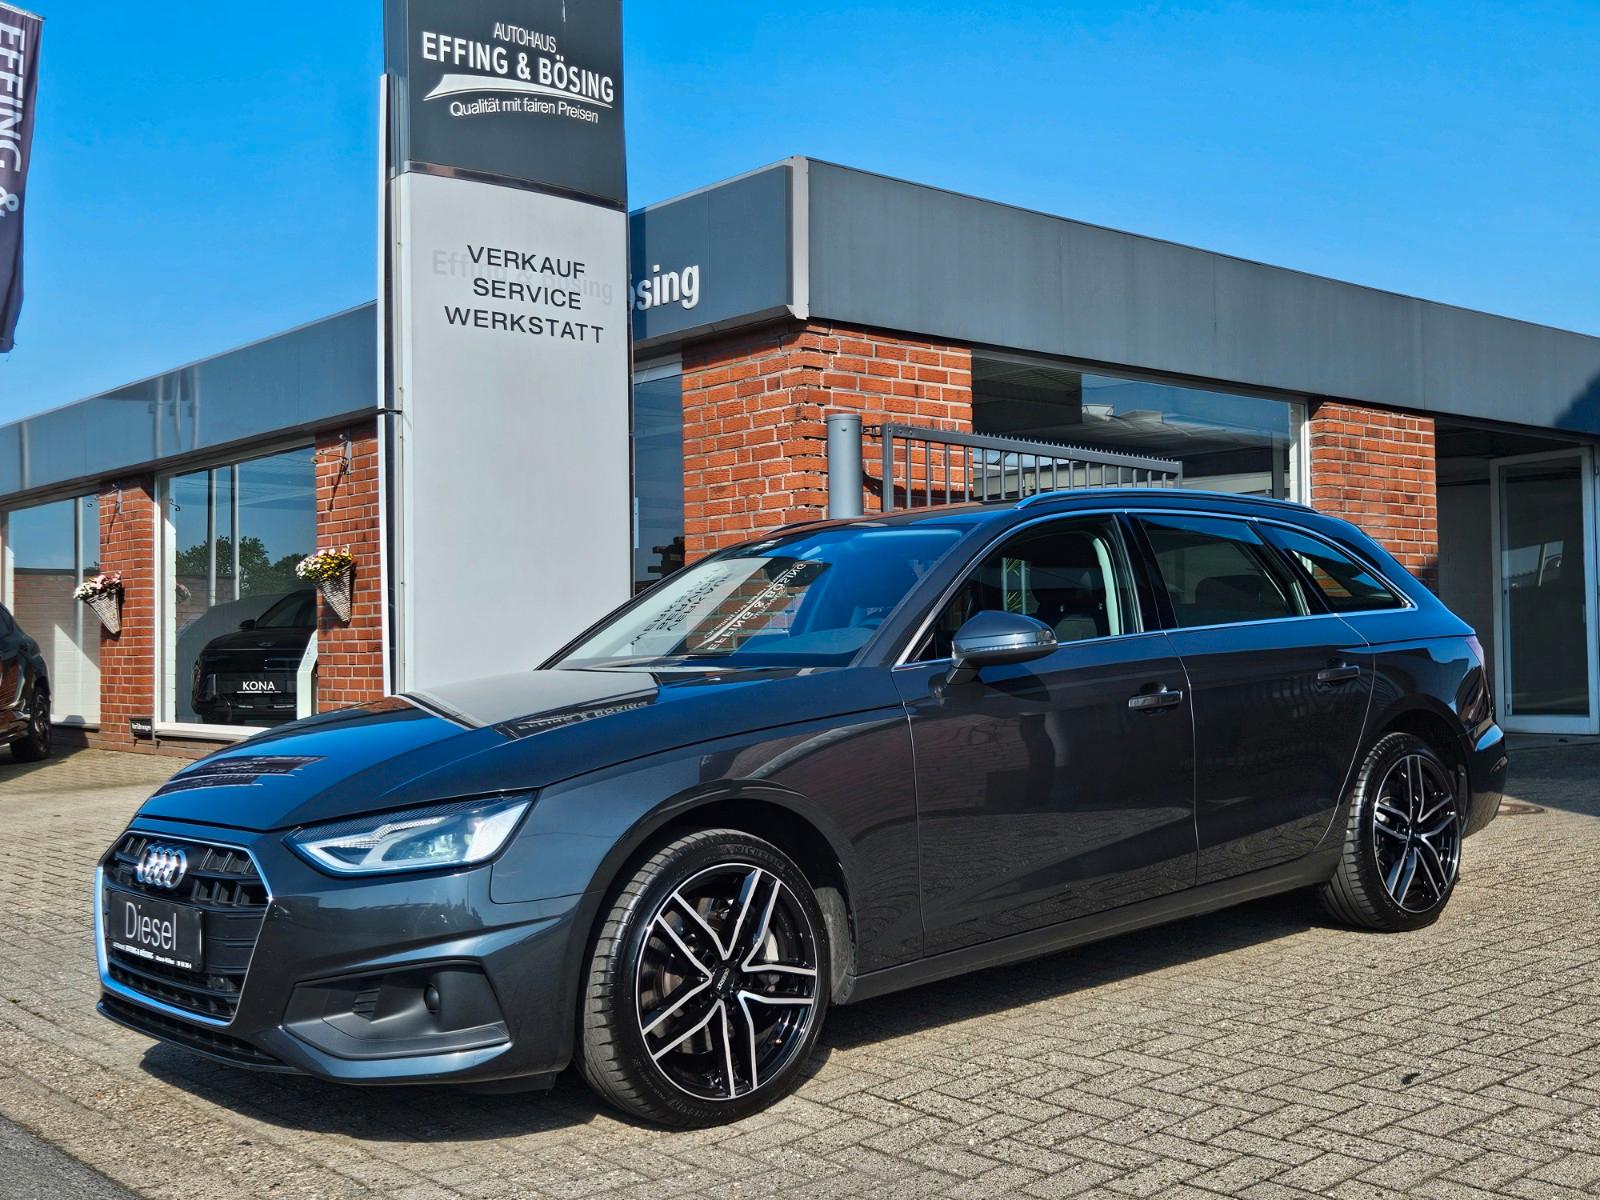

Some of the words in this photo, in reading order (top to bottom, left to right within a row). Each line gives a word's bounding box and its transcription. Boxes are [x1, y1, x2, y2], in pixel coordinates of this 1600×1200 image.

[493, 22, 557, 53] AUTOHAUS
[422, 31, 508, 75] EFFING
[516, 52, 531, 80] &
[539, 55, 614, 103] BÖSING
[0, 22, 25, 172] EFFING
[450, 97, 500, 117] Qualität
[502, 99, 522, 114] mit
[523, 97, 556, 115] fairen
[558, 102, 599, 124] Preisen
[0, 186, 19, 217] &
[467, 244, 585, 280] VERKAUF
[473, 277, 582, 310] SERVICE
[444, 305, 604, 343] WERKSTATT
[242, 680, 275, 691] KONA
[125, 902, 176, 951] Diesel
